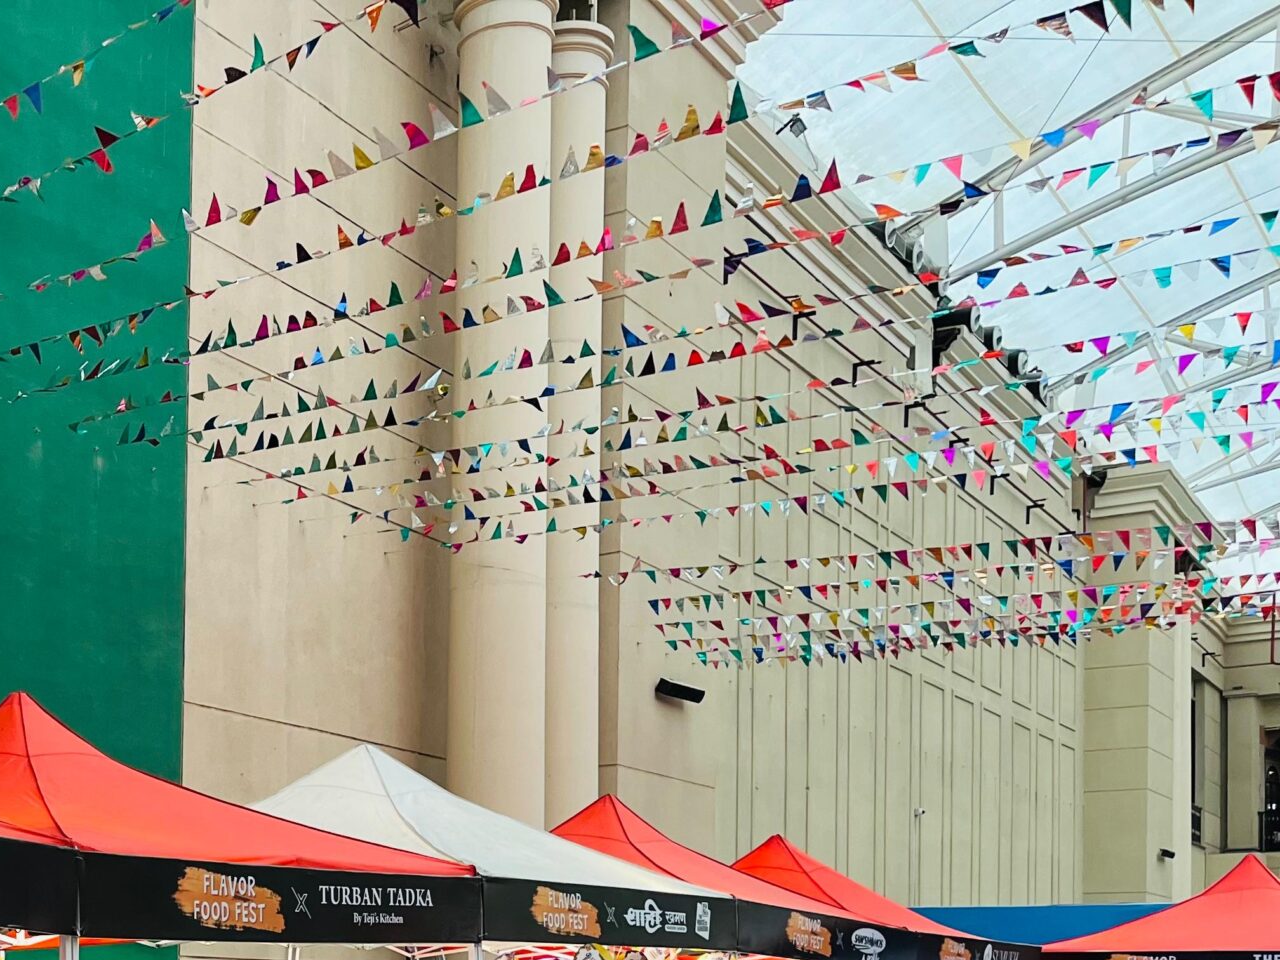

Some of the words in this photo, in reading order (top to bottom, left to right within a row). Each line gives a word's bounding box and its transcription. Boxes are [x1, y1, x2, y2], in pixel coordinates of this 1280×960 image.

[203, 875, 256, 897] FLAVOR
[319, 885, 381, 906] TURBAN
[387, 888, 433, 907] TADKA
[548, 892, 582, 910] FLAVOR
[193, 900, 230, 923] FOOD
[235, 902, 265, 923] FEST
[353, 912, 362, 926] By
[363, 912, 379, 925] Teji's
[380, 913, 404, 924] Kitchen
[543, 911, 567, 928] FOOD
[569, 914, 588, 929] FEST
